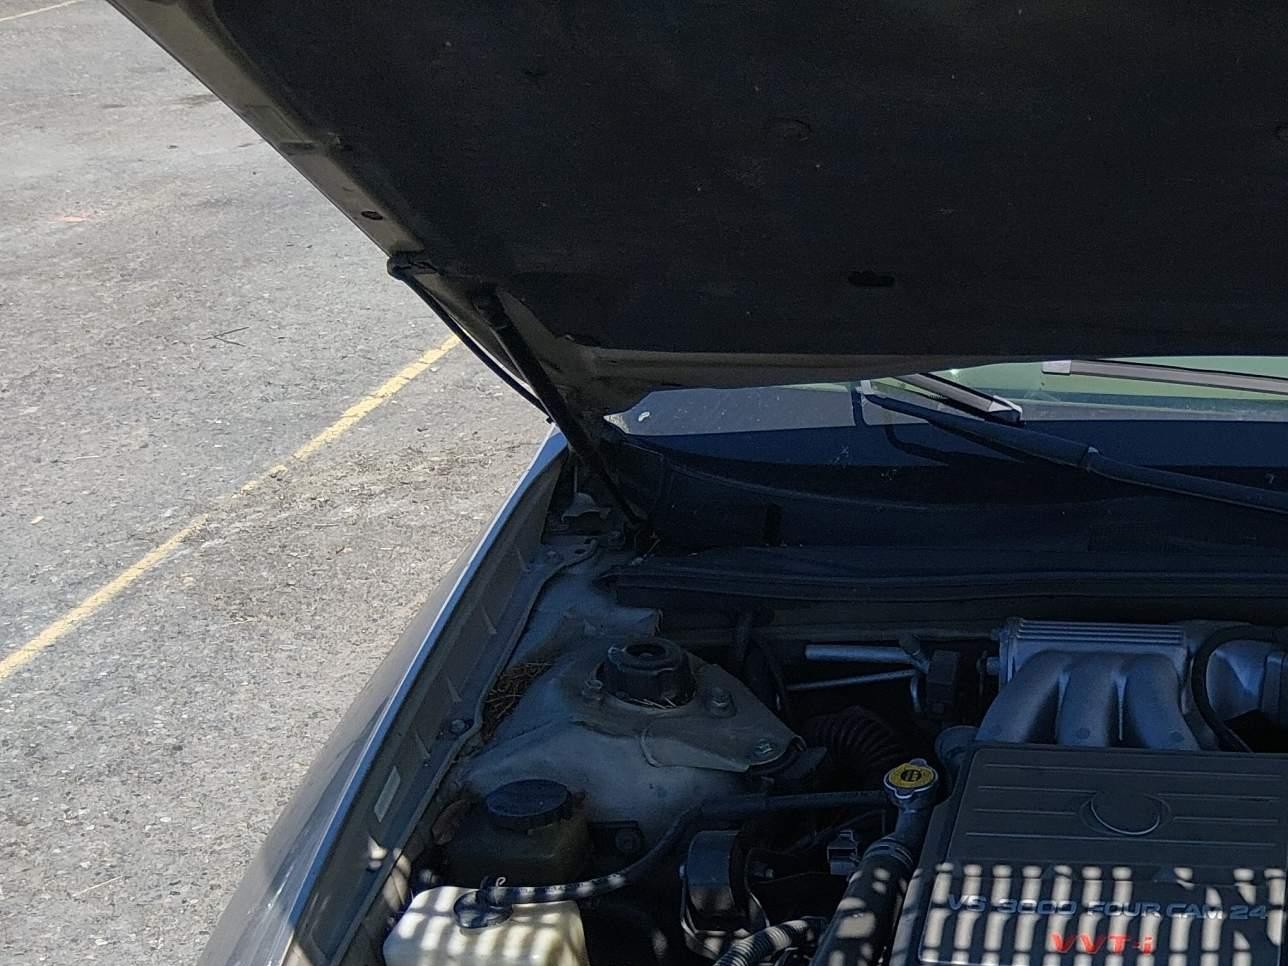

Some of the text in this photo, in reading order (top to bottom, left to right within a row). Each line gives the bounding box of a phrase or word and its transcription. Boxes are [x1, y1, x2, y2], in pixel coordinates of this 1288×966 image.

[996, 898, 1077, 915] 3000
[1085, 900, 1162, 919] FOUR
[1166, 903, 1224, 920] CAM
[1230, 904, 1268, 920] 24
[1050, 931, 1153, 954] VVT-i
